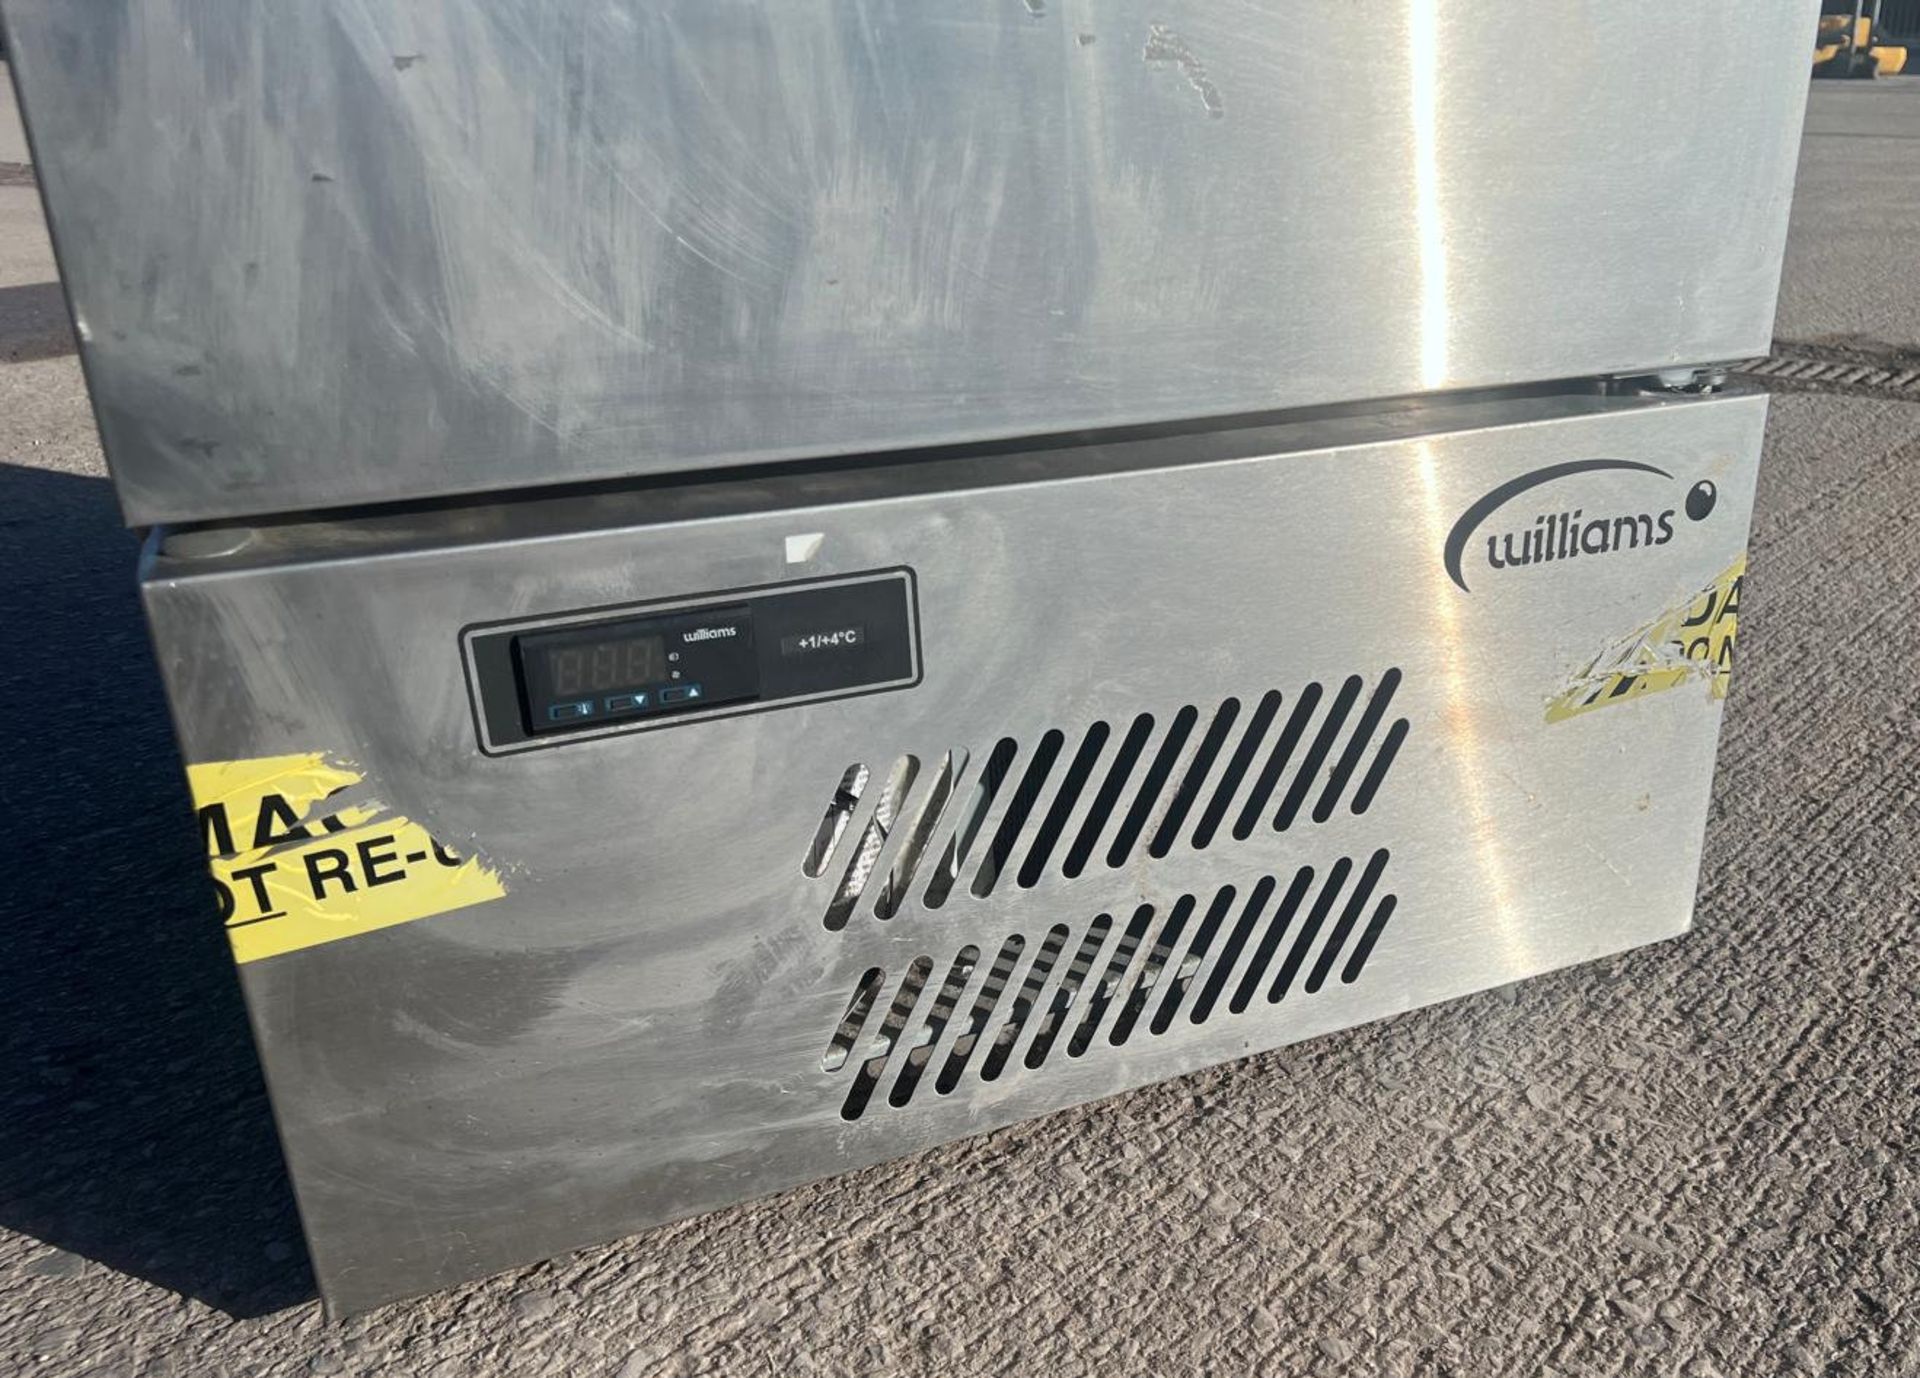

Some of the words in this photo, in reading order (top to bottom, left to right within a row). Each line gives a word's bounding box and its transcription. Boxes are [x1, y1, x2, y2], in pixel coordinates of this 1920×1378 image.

[1487, 509, 1676, 569] williams
[683, 626, 737, 643] williams
[799, 630, 857, 649] +1/+4°C
[199, 794, 347, 856] MA
